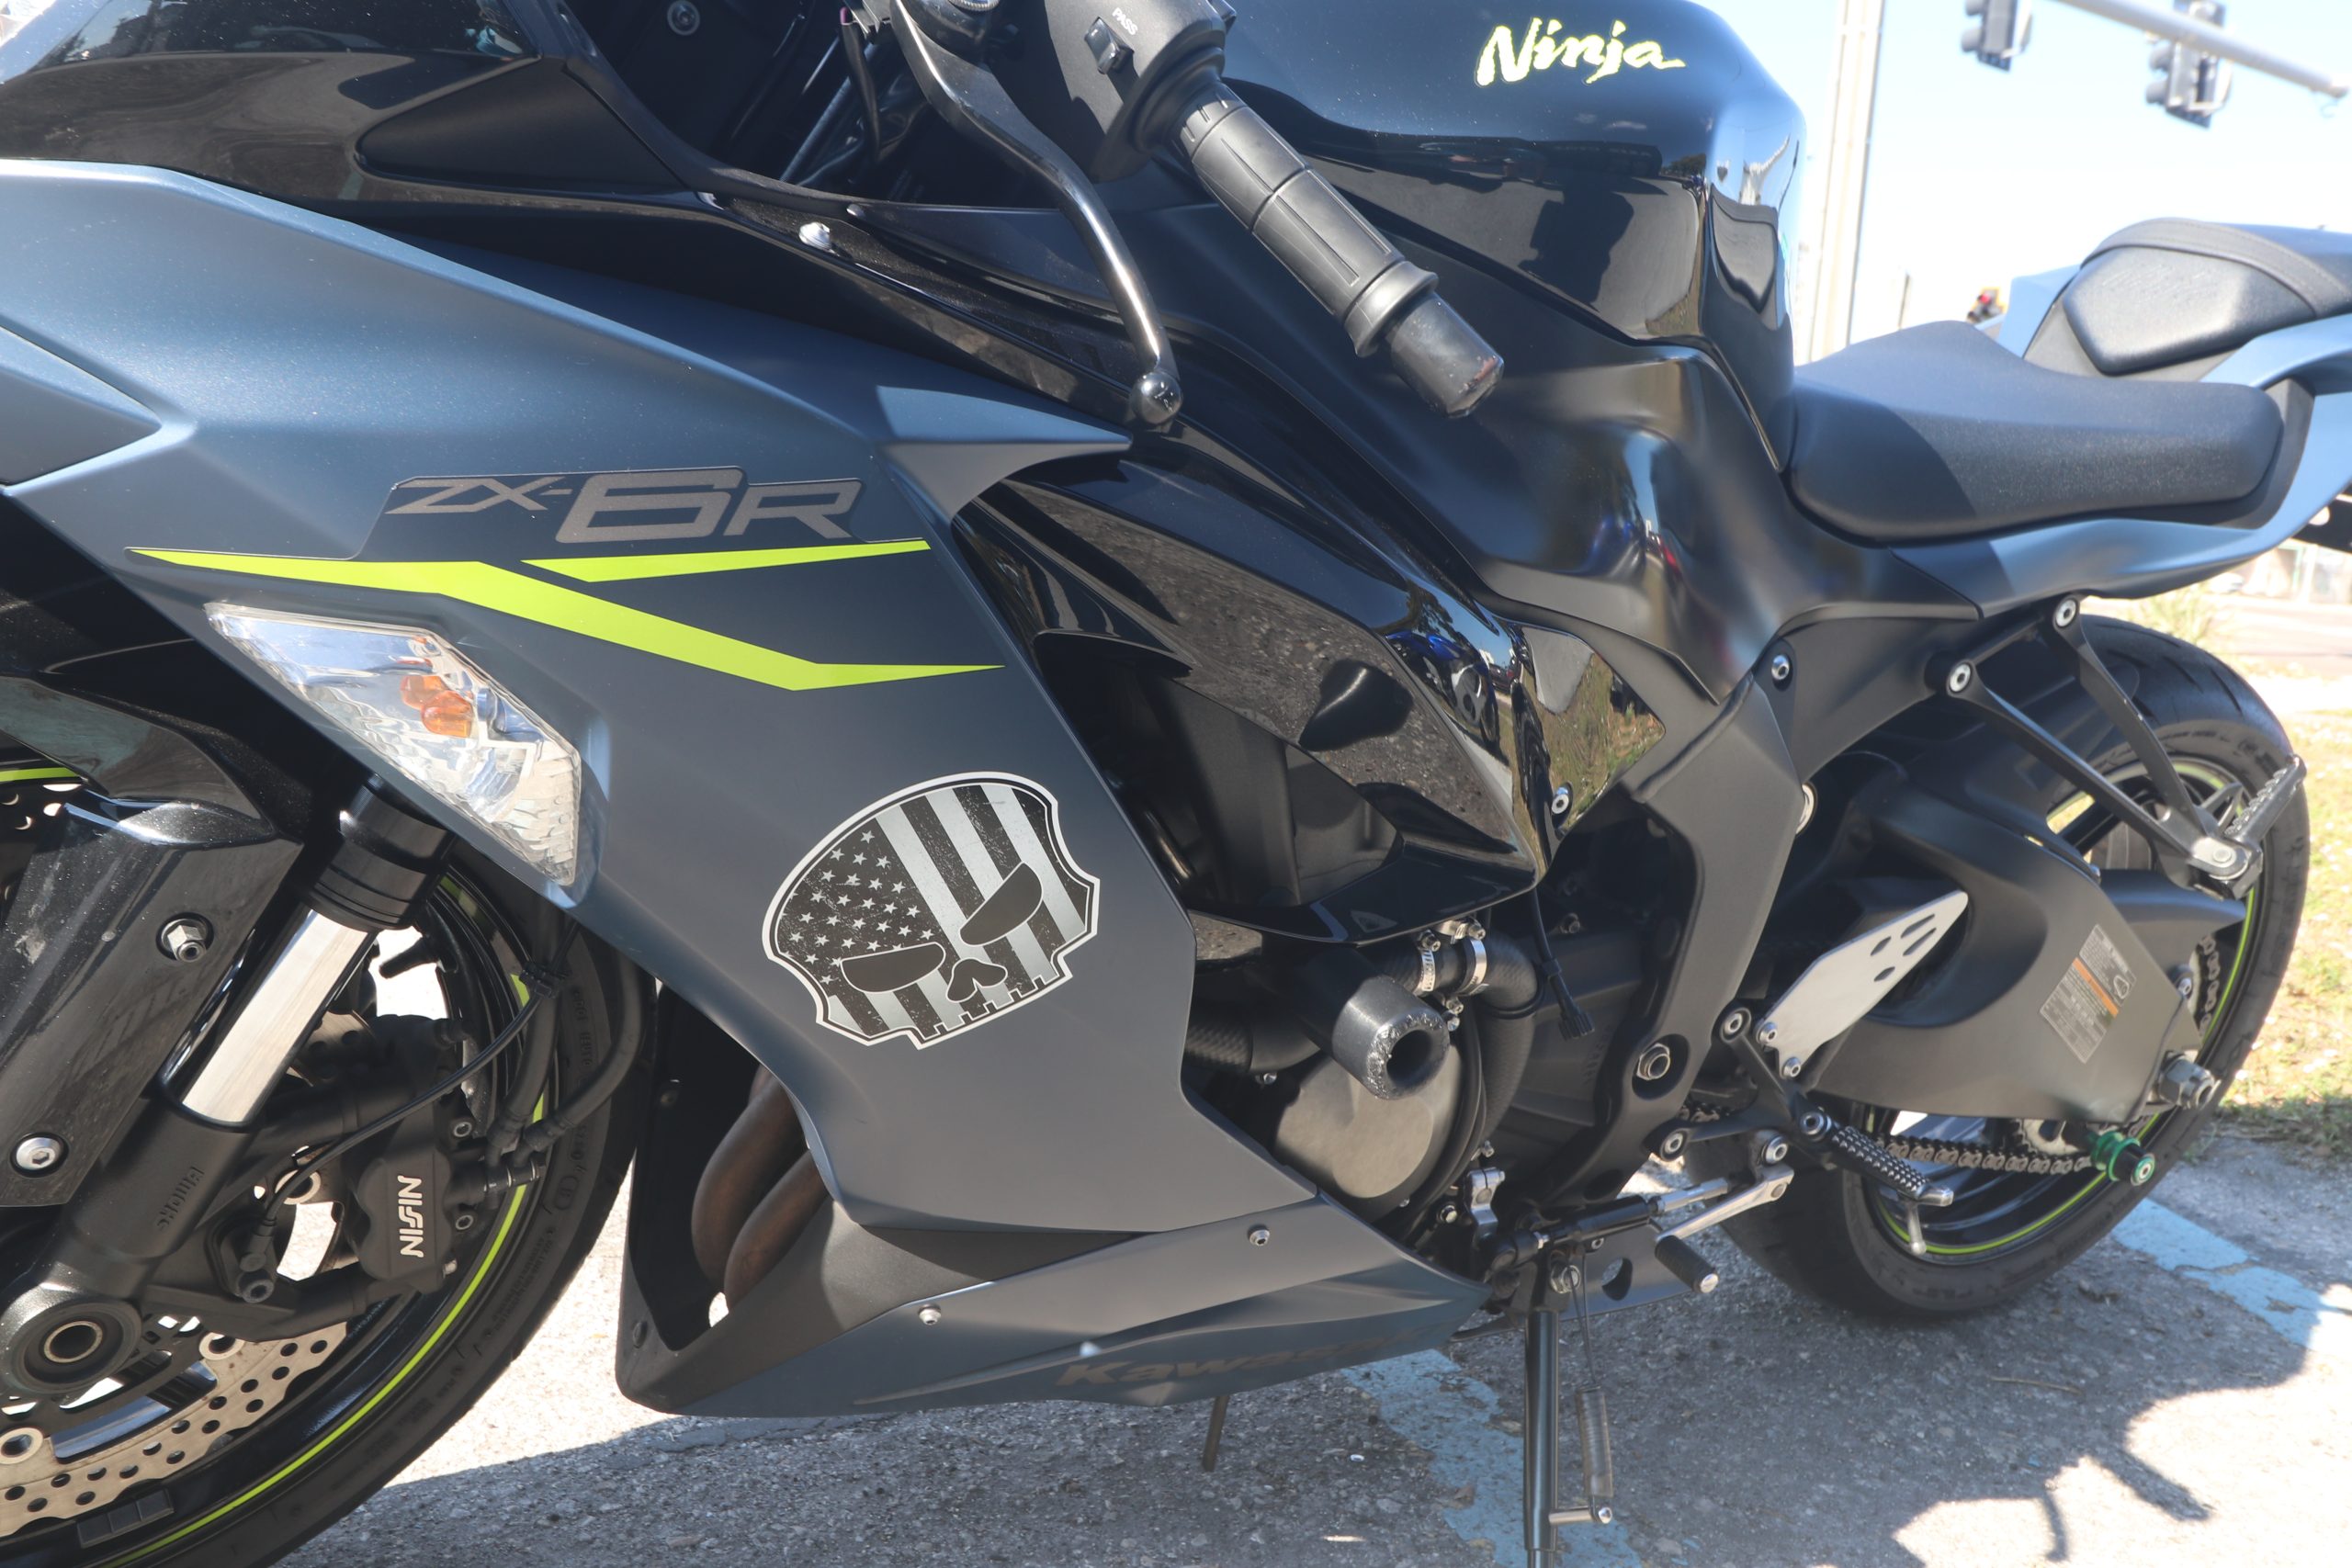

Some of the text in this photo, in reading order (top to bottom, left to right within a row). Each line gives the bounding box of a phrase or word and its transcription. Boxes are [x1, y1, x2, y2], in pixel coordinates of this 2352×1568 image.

[1112, 6, 1138, 36] PASS
[1476, 17, 1687, 86] Ninja
[384, 467, 863, 544] ZX-6R
[397, 1175, 424, 1258] NISSIN
[1054, 1320, 1459, 1387] Kawas
